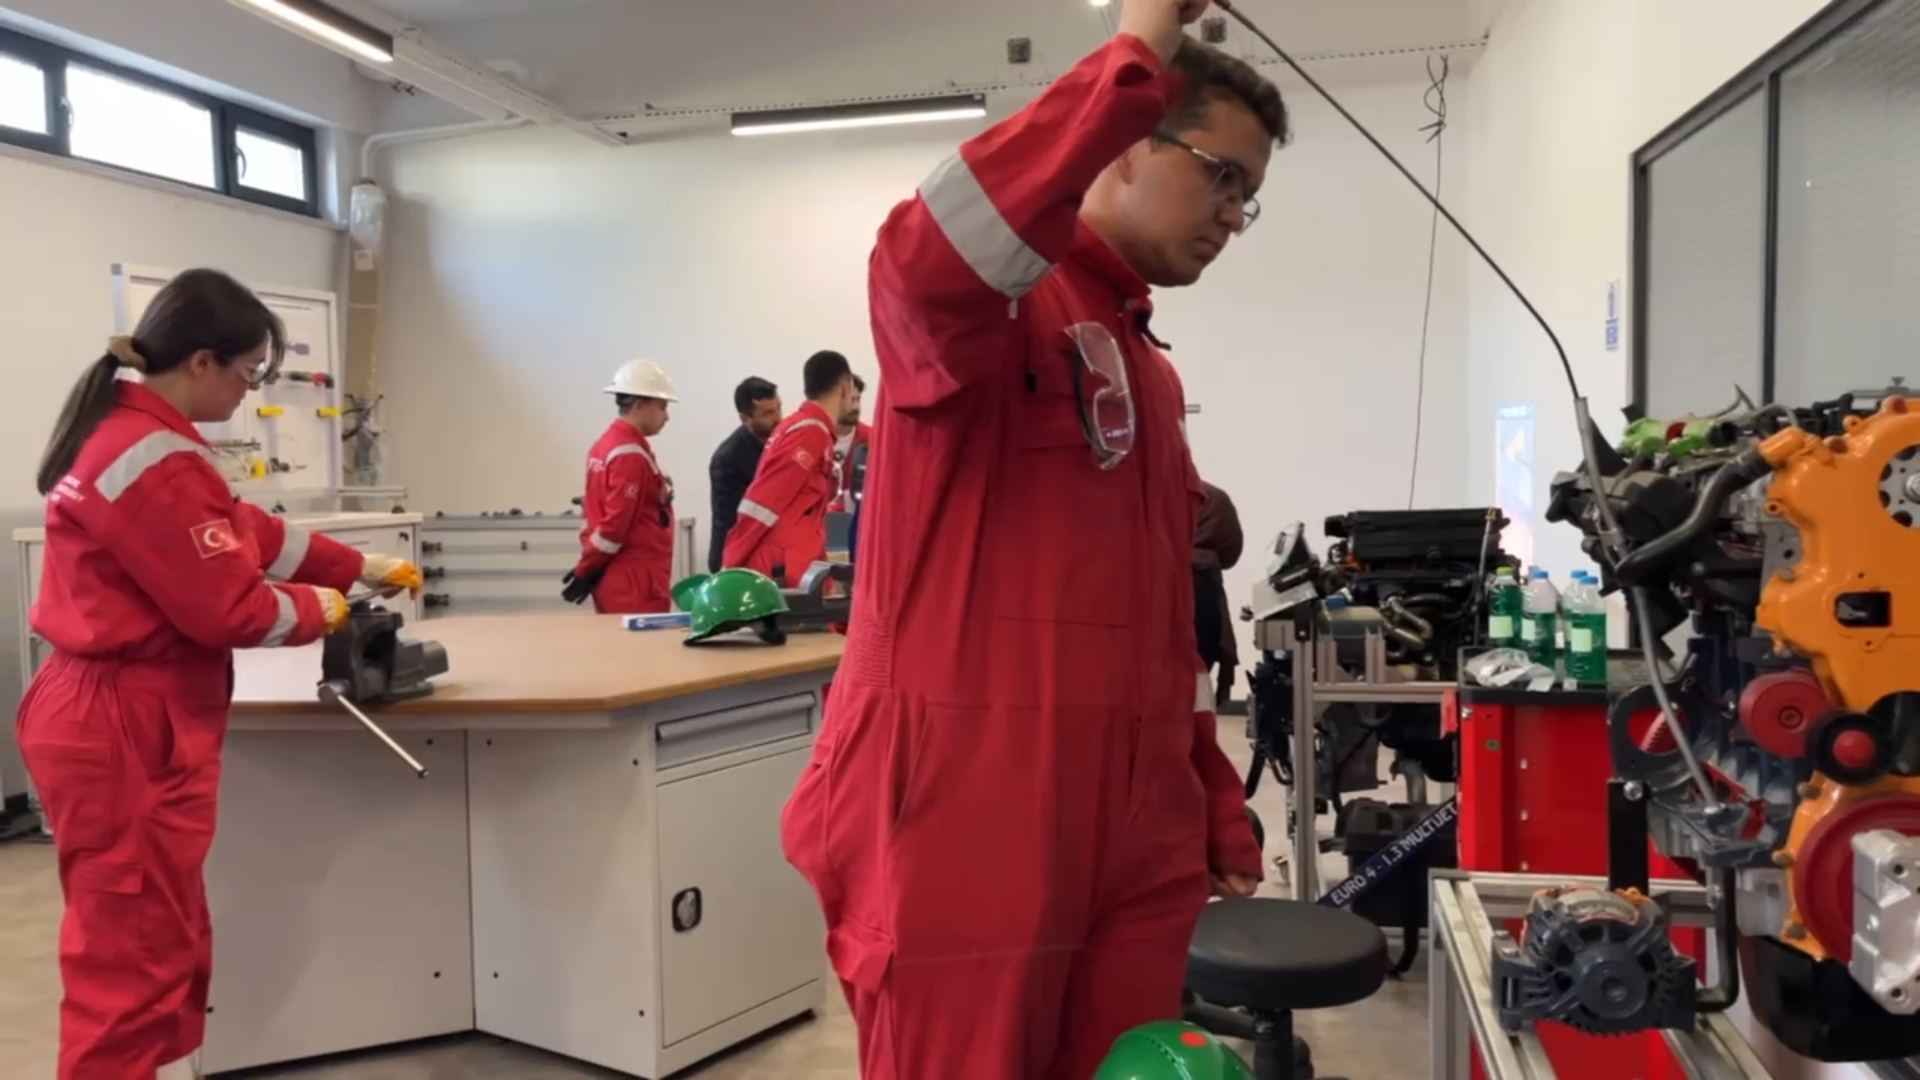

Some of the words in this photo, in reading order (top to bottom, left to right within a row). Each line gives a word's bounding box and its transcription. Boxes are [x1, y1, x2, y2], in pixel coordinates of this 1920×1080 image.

[1330, 875, 1366, 905] EURO
[1367, 867, 1377, 878] 4
[1381, 846, 1402, 867] 1.3
[1400, 802, 1458, 851] MULTIJET
